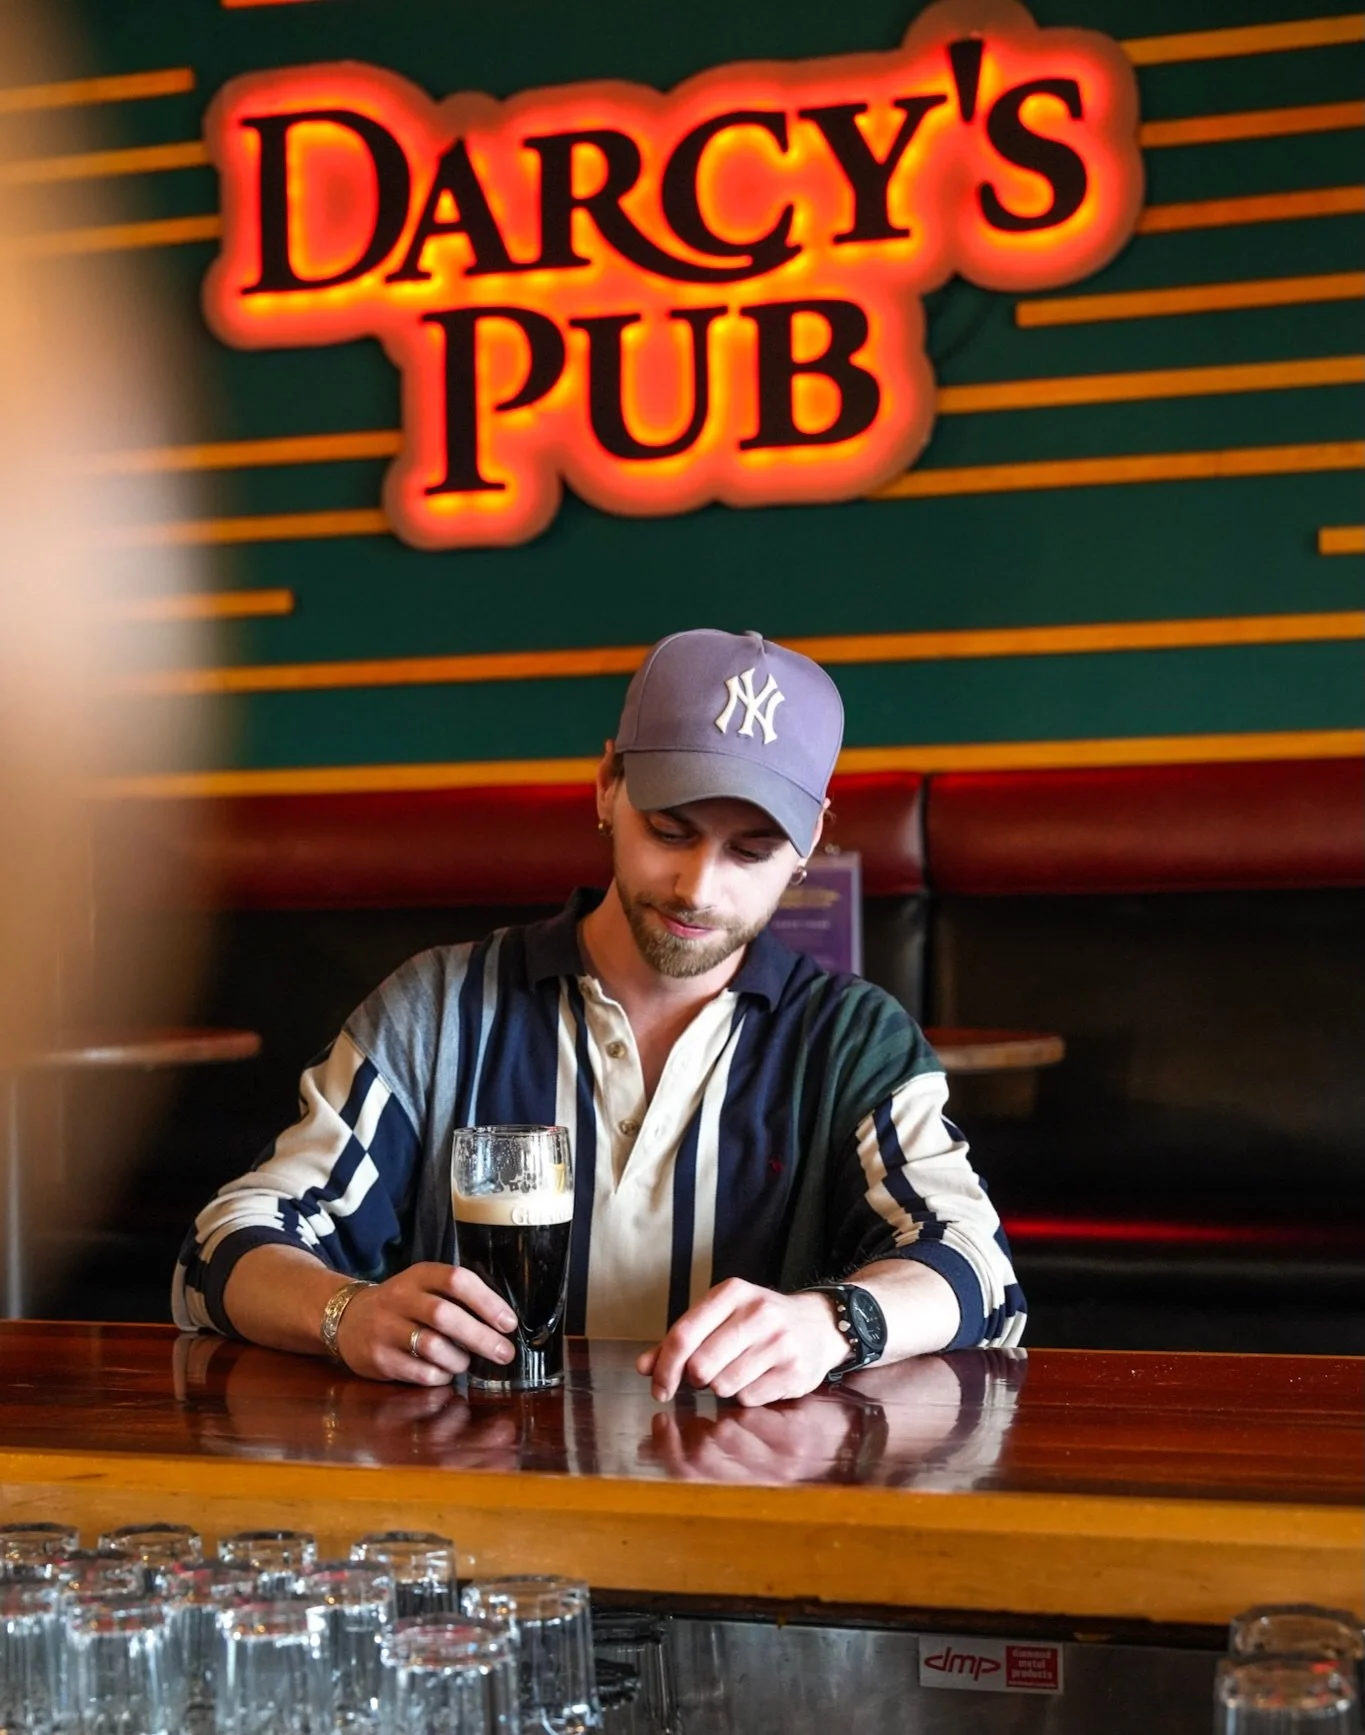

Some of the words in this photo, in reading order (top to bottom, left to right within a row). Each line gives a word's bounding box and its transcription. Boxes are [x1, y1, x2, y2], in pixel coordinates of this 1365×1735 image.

[240, 39, 1087, 295] DARCY'S
[421, 299, 881, 496] PUB
[714, 667, 786, 745] NY
[924, 1646, 1001, 1681] dmp
[1018, 1659, 1046, 1669] metal
